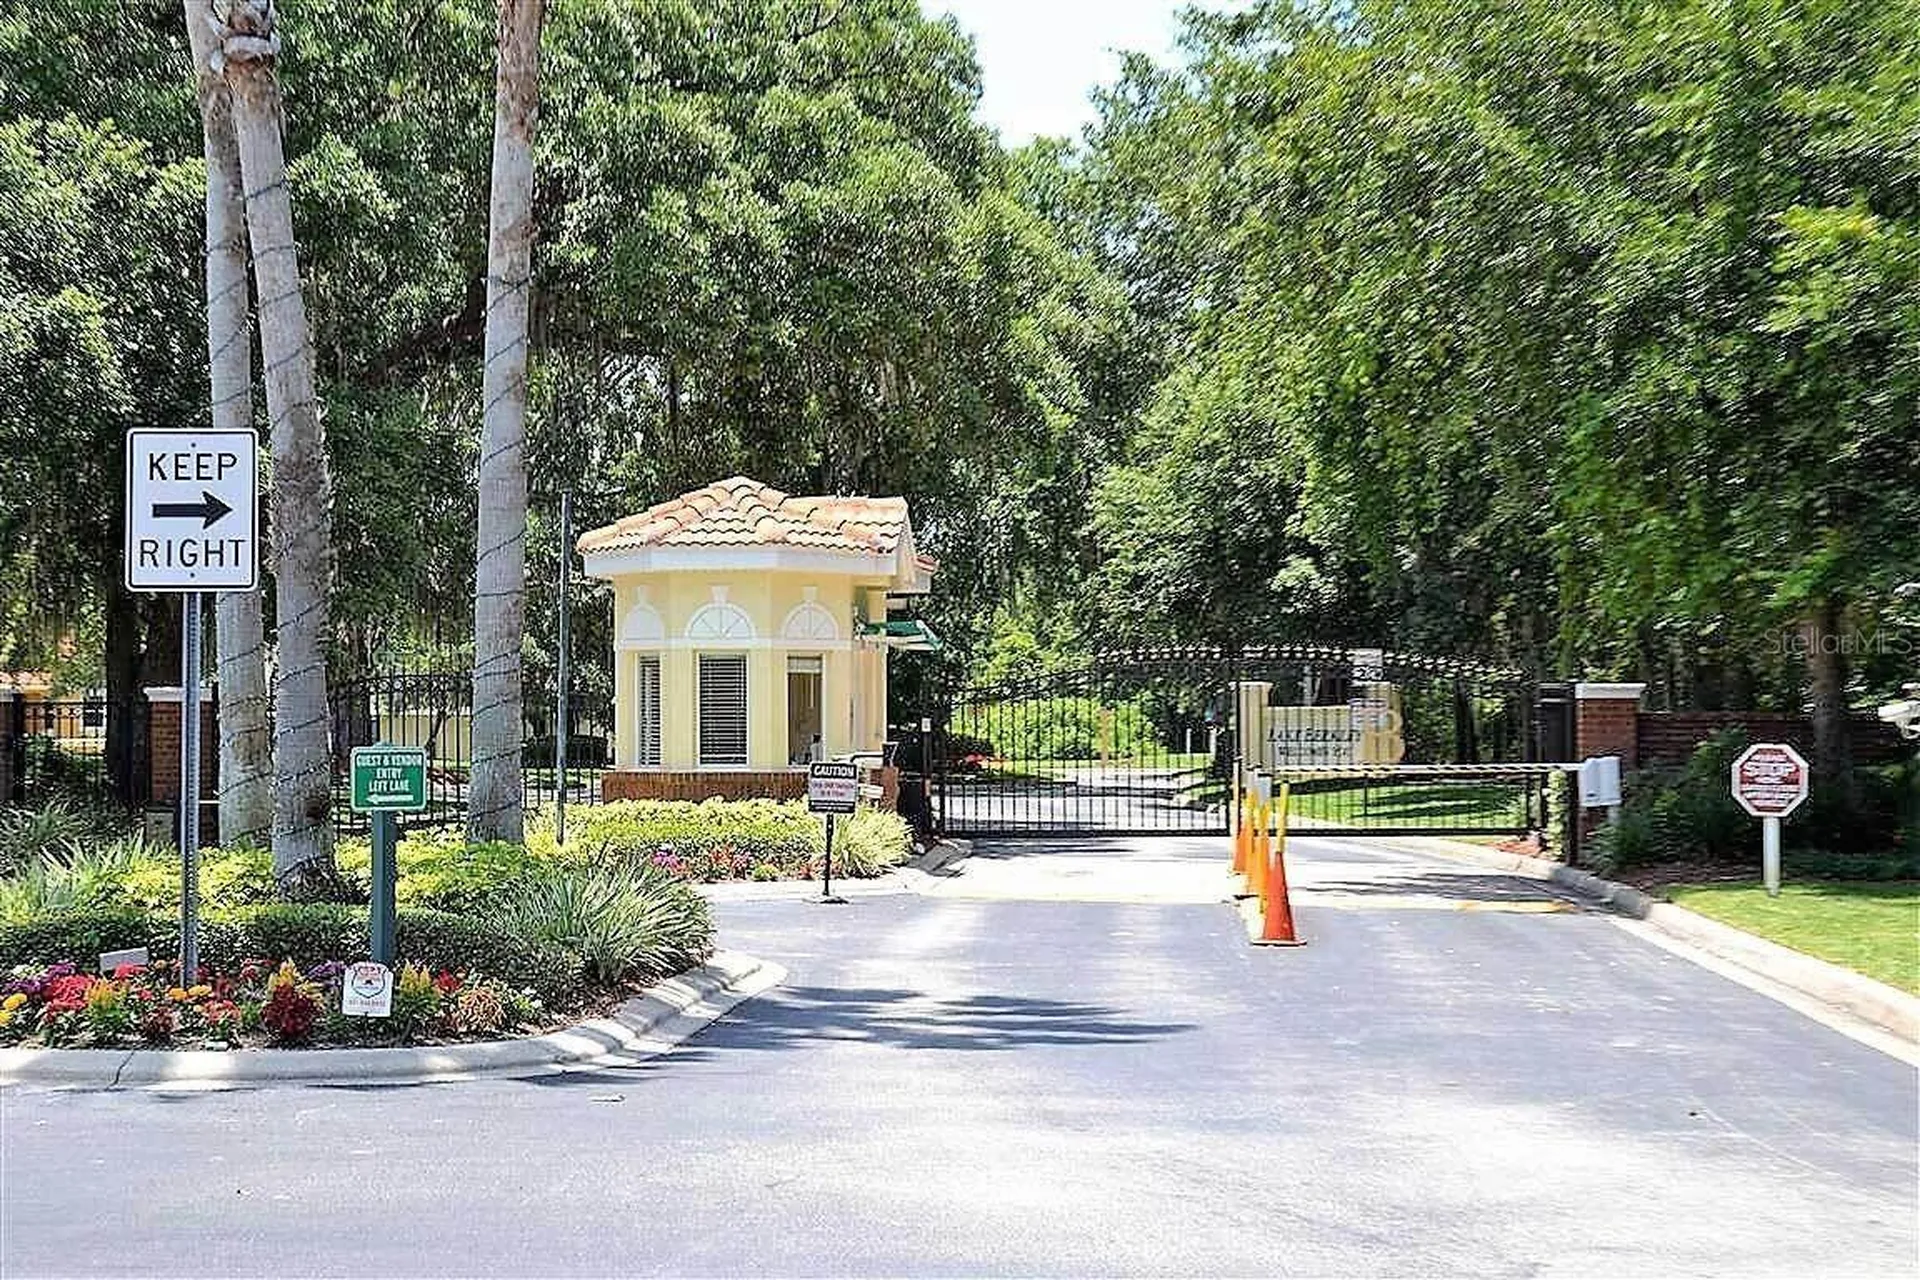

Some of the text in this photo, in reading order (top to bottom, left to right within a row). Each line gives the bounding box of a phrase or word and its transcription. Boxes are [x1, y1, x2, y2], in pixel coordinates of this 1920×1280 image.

[148, 452, 238, 481] KEEP
[139, 538, 246, 568] RIGHT
[391, 754, 422, 767] VENDOR
[813, 765, 855, 777] CAUTION
